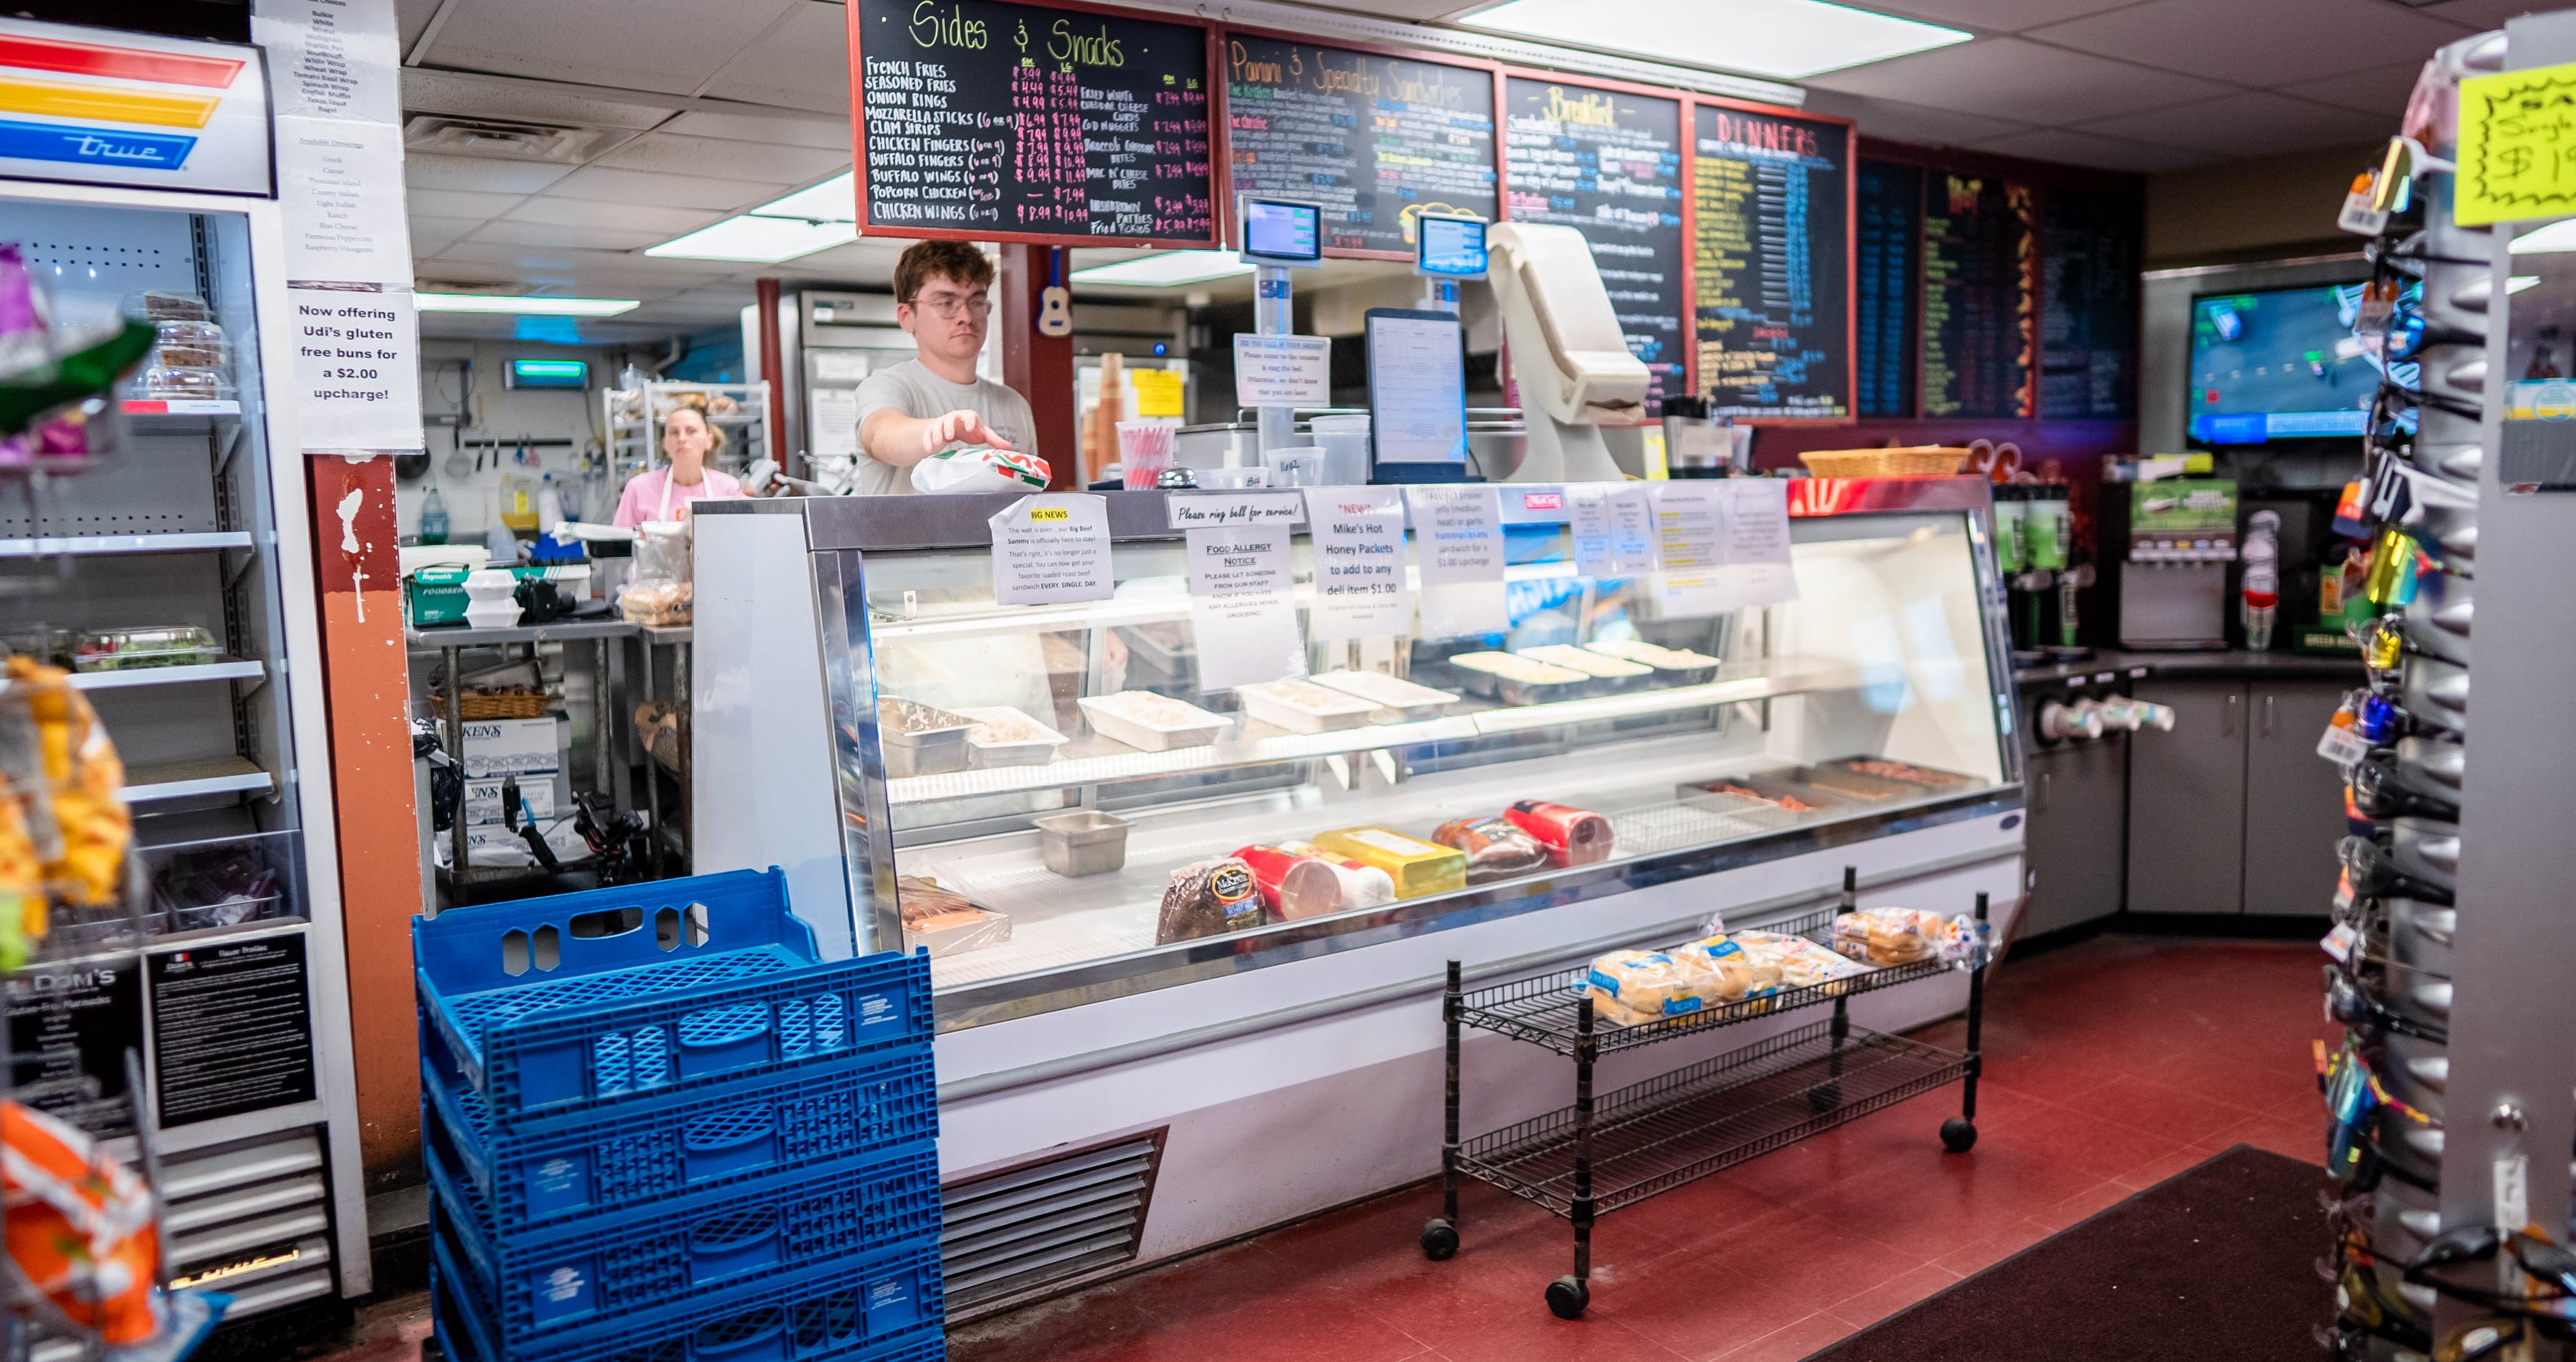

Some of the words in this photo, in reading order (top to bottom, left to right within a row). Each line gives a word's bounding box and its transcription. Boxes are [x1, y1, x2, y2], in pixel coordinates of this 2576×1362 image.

[312, 18, 334, 26] White
[908, 0, 987, 49] Sides
[1047, 19, 1124, 67] Snacks
[306, 49, 343, 59] Sourdough
[1231, 40, 1282, 83] Panini
[303, 65, 326, 73] Wheat
[328, 68, 347, 76] Wrap
[915, 62, 947, 78] FRIES
[293, 71, 320, 80] Tomato
[340, 76, 358, 85] Wrap
[865, 76, 923, 91] SEASONED
[927, 78, 956, 93] FRIES
[302, 81, 329, 89] Spinach
[331, 84, 350, 92] Wrap
[867, 91, 906, 104] ONION
[912, 94, 948, 108] RINGS
[865, 106, 931, 123] MOZZARELLA
[933, 111, 974, 124] STICKS
[870, 120, 901, 135] CLAM
[905, 122, 941, 136] STRIPS
[1717, 113, 1818, 156] DINNERS
[63, 136, 164, 161] true
[869, 136, 920, 151] CHICKEN
[923, 138, 969, 152] FINGERS
[869, 152, 915, 167] BUFFALO
[918, 154, 964, 168] FINGERS
[870, 168, 919, 183] BUFFALO
[923, 170, 961, 183] WINGS
[870, 184, 918, 199] POPCORN
[922, 186, 967, 199] CHICKEN
[873, 201, 922, 220] CHICKEN
[924, 205, 965, 220] WINGS
[299, 304, 333, 316] Now
[338, 308, 395, 321] offering
[303, 326, 341, 337] Udi's
[346, 328, 393, 340] gluten
[301, 346, 331, 357] free
[336, 348, 372, 358] buns
[376, 349, 397, 359] for
[323, 369, 331, 378] a
[337, 368, 378, 379] $2.00
[313, 389, 388, 401] upcharge!
[1045, 511, 1068, 519] NEWS
[1179, 507, 1205, 520] Please
[1209, 508, 1225, 523] ring
[1229, 504, 1247, 518] bell
[1249, 504, 1262, 521] for
[1265, 503, 1298, 516] service!
[1333, 524, 1364, 533] Mike's
[1366, 524, 1383, 533] Hot
[1326, 544, 1356, 556] Honey
[1359, 544, 1394, 553] Packets
[1331, 566, 1341, 574] to
[1343, 564, 1361, 574] add
[1363, 565, 1373, 574] to
[1376, 565, 1392, 575] any
[1327, 585, 1344, 595] deli
[1347, 584, 1369, 594] item
[1371, 583, 1396, 594] $1.00
[462, 724, 501, 738] KEN'S
